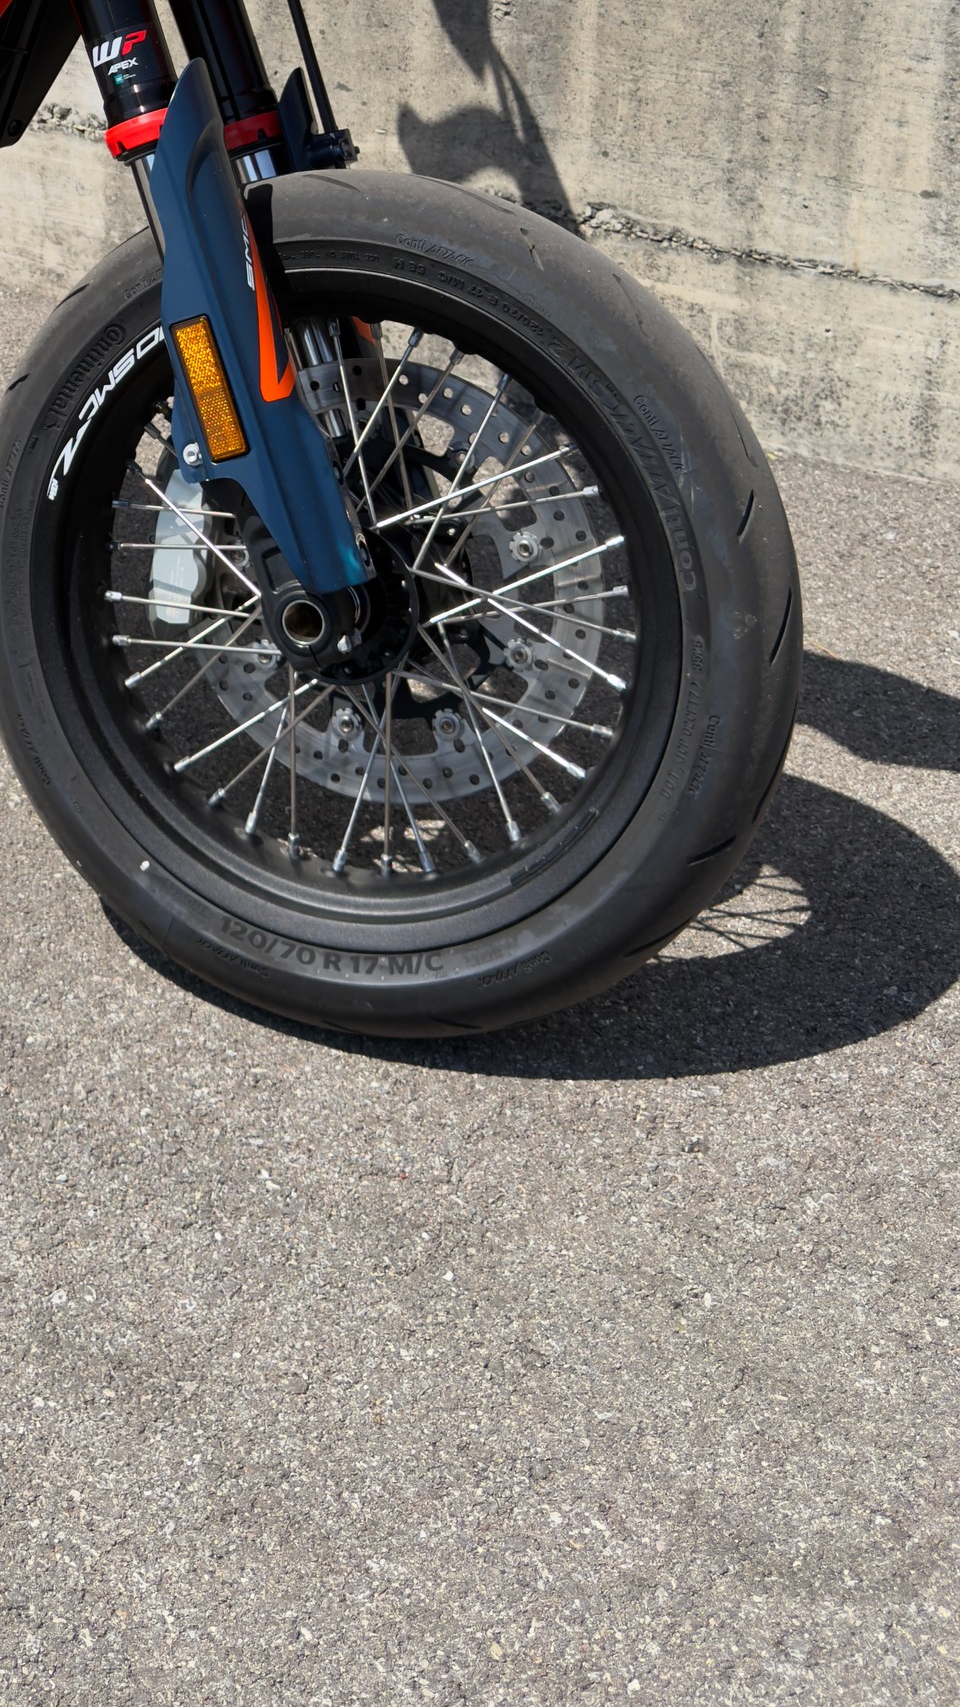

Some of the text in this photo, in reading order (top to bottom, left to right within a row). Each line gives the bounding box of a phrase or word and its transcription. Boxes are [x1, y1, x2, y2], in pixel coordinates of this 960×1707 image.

[92, 29, 147, 68] WP
[108, 57, 139, 76] APEX
[47, 323, 128, 416] Continental
[220, 915, 445, 977] 120/70 R 17 M/C
